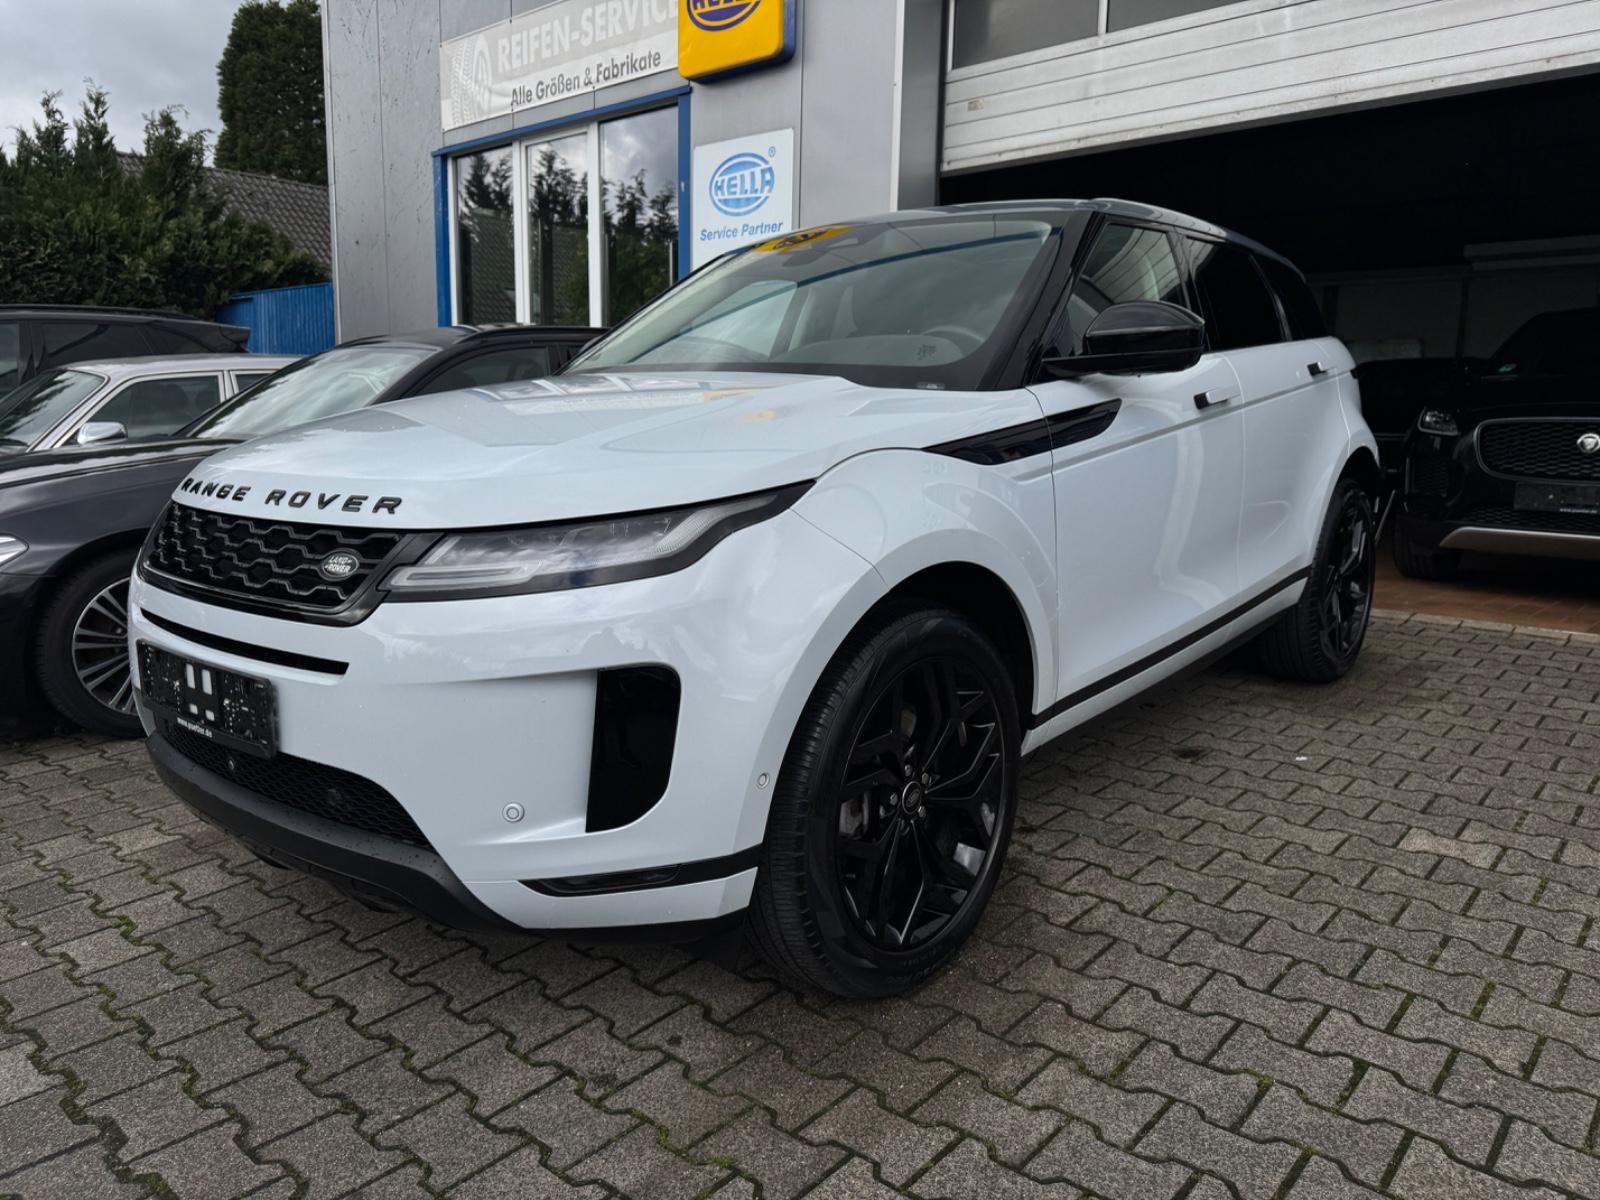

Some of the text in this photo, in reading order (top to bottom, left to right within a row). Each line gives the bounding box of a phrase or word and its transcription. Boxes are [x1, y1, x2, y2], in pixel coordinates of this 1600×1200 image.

[511, 51, 661, 106] Alle Größen & Fabrikate
[714, 166, 775, 197] HELLA
[700, 221, 784, 241] Service Partner
[181, 477, 402, 515] RANGE ROVER
[328, 563, 351, 573] ROVER
